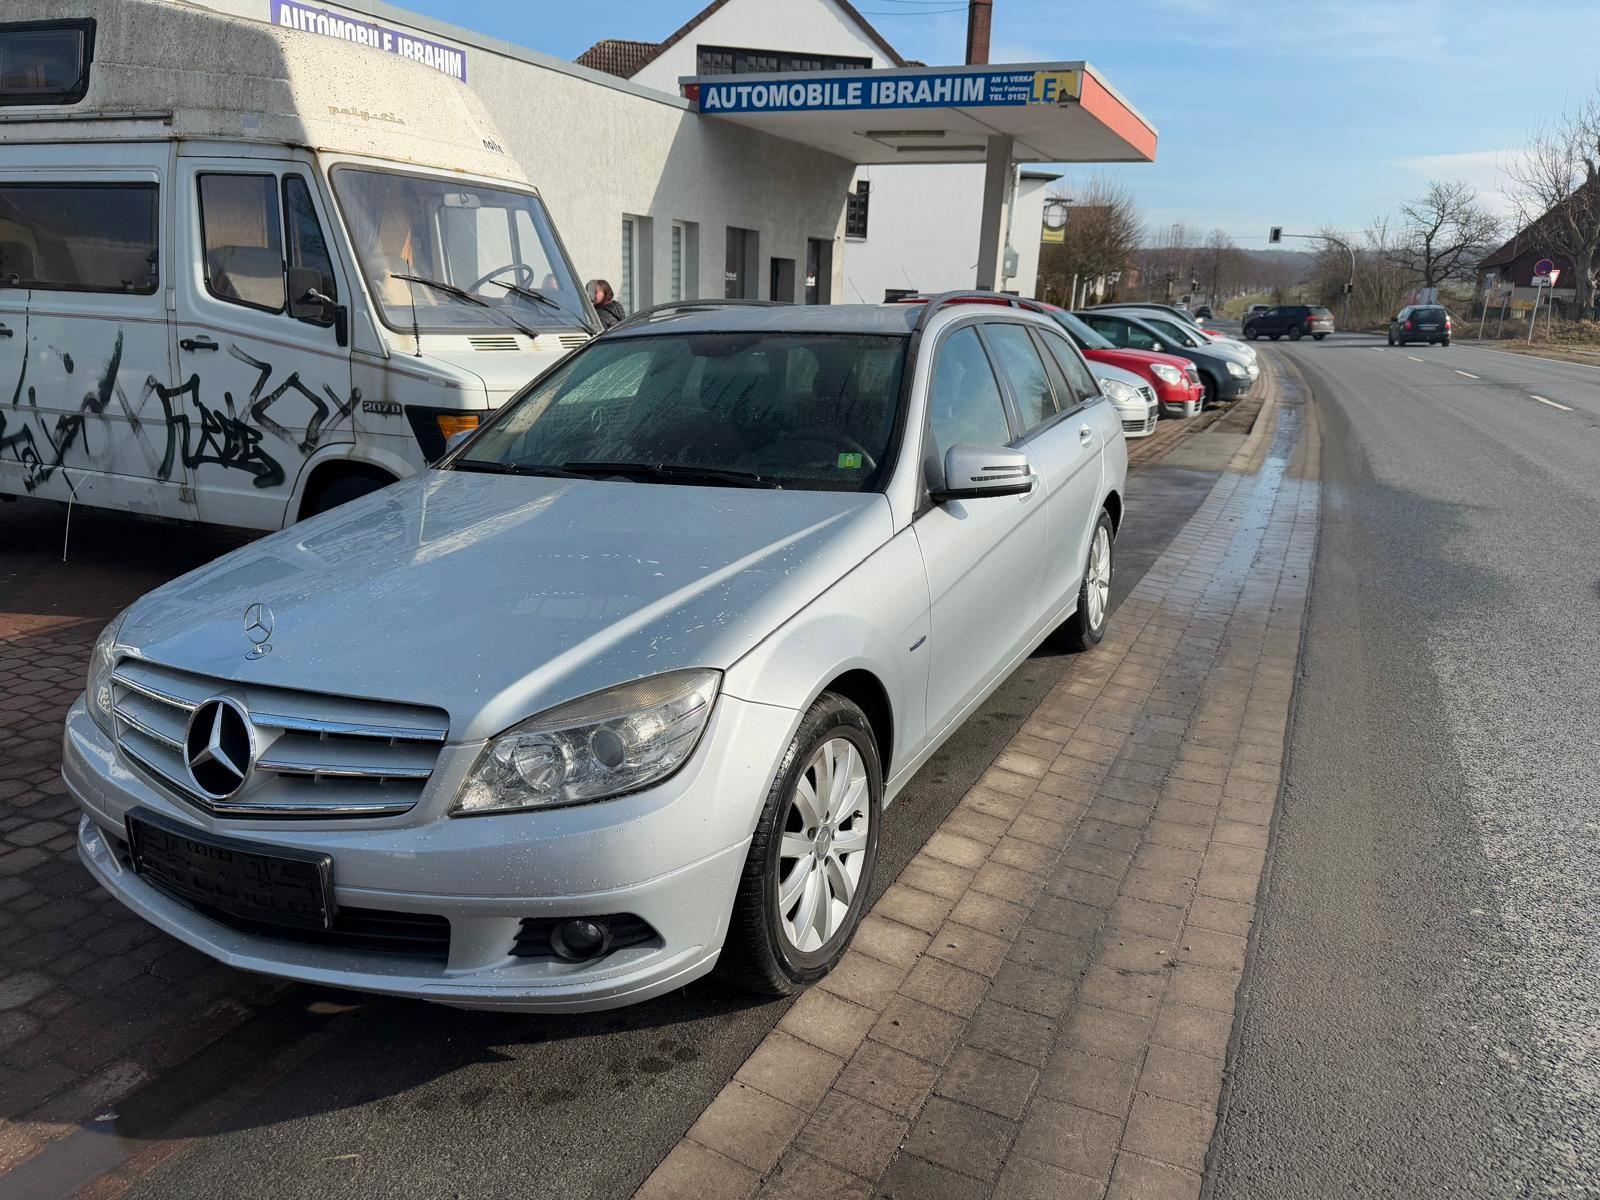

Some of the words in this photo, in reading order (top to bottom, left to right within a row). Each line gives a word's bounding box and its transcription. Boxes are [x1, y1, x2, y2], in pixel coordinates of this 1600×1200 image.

[705, 82, 863, 109] AUTOMOBILE
[871, 77, 985, 105] IBRAHIM
[989, 93, 1006, 101] TEL.
[1007, 93, 1027, 101] 0152
